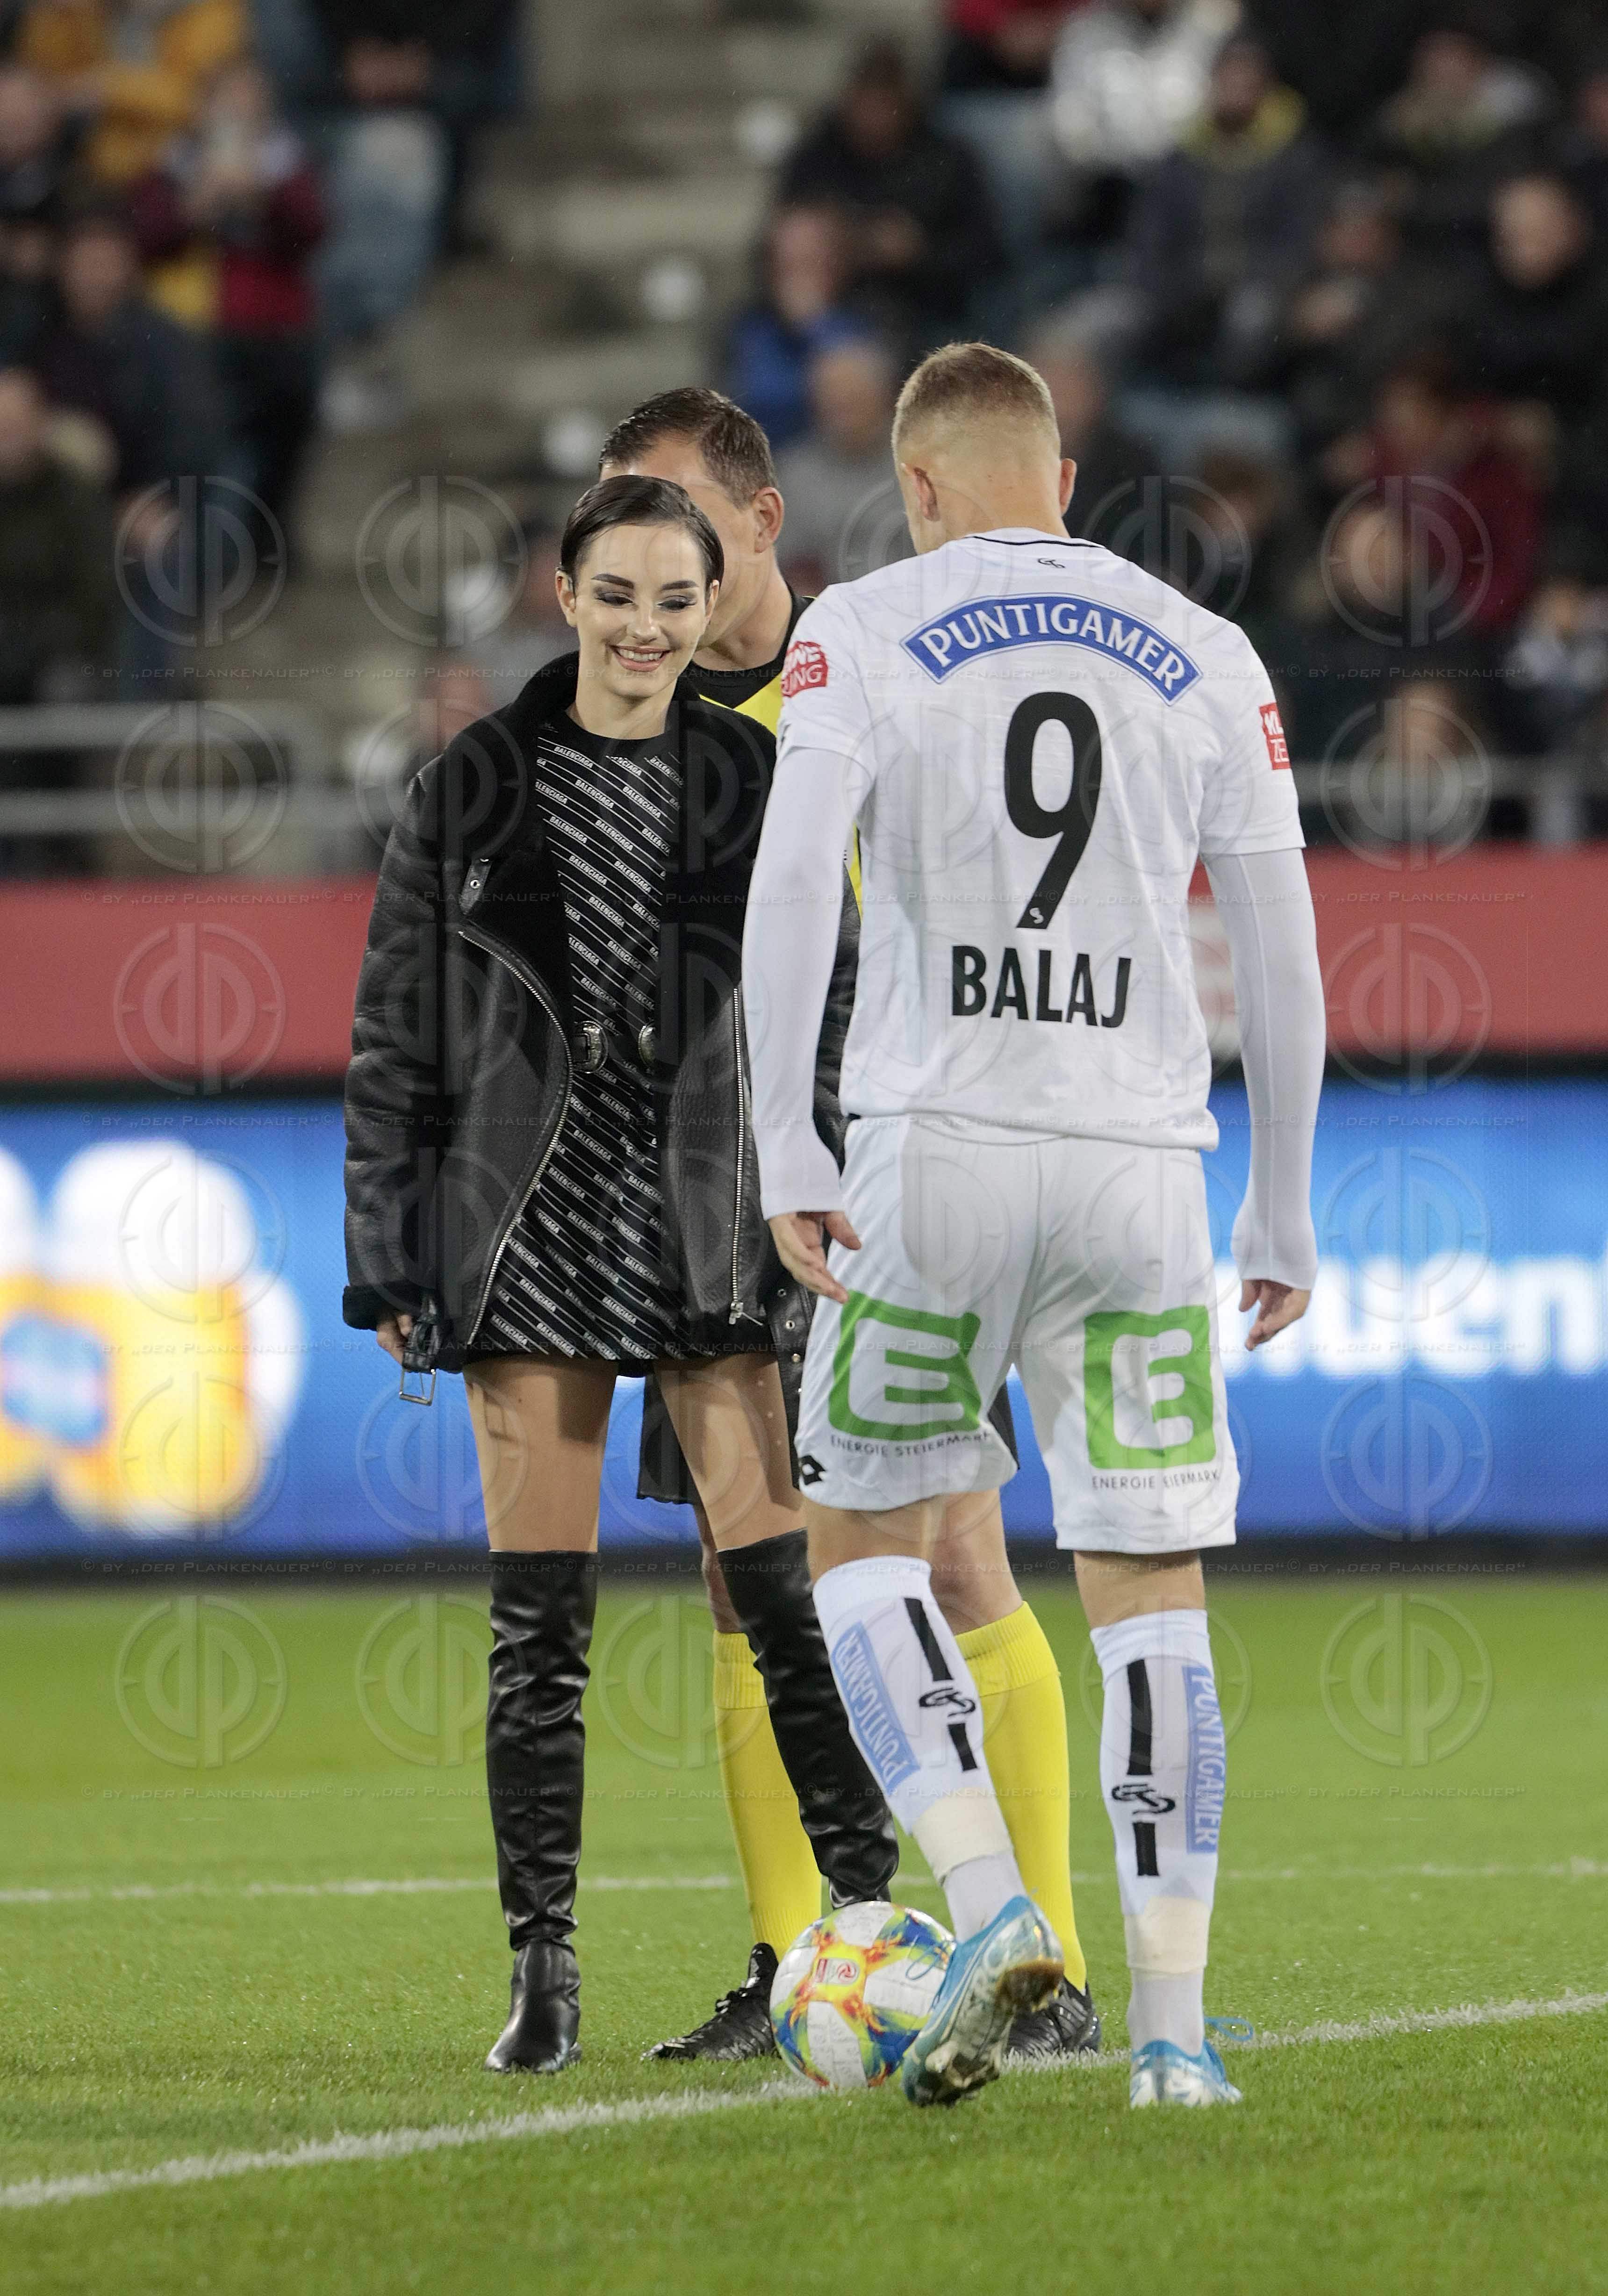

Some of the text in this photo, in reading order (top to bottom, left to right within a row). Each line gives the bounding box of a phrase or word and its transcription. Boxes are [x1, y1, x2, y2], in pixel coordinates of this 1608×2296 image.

[919, 603, 1184, 691] PUNTIGAMER
[554, 746, 593, 768] BALENCIAGA
[575, 780, 614, 809] BALENCIAGA
[623, 786, 661, 818] BALENCIAGA
[1004, 692, 1102, 930] 9
[550, 816, 588, 843] BALENCIAGA
[595, 820, 633, 851] BALENCIAGA
[569, 855, 607, 885] BALENCIAGA
[614, 861, 652, 893] BALENCIAGA
[589, 897, 625, 927] BALENCIAGA
[608, 941, 642, 970] BALENCIAGA
[952, 945, 1132, 1028] BALAJ
[574, 1130, 612, 1161] BALENCIAGA
[548, 1168, 585, 1199] BALENCIAGA
[567, 1212, 604, 1242] BALENCIAGA
[519, 1278, 556, 1313] BALENCIAGA
[602, 1297, 637, 1324] BALENCIAGA
[537, 1323, 575, 1356] BALENCIAGA
[831, 1434, 888, 1457] ENERGIE
[1092, 1476, 1156, 1490] ENERGIE
[836, 1632, 909, 1783] PUNTIGAMER
[1192, 1674, 1225, 1844] PUNTIGAMER
